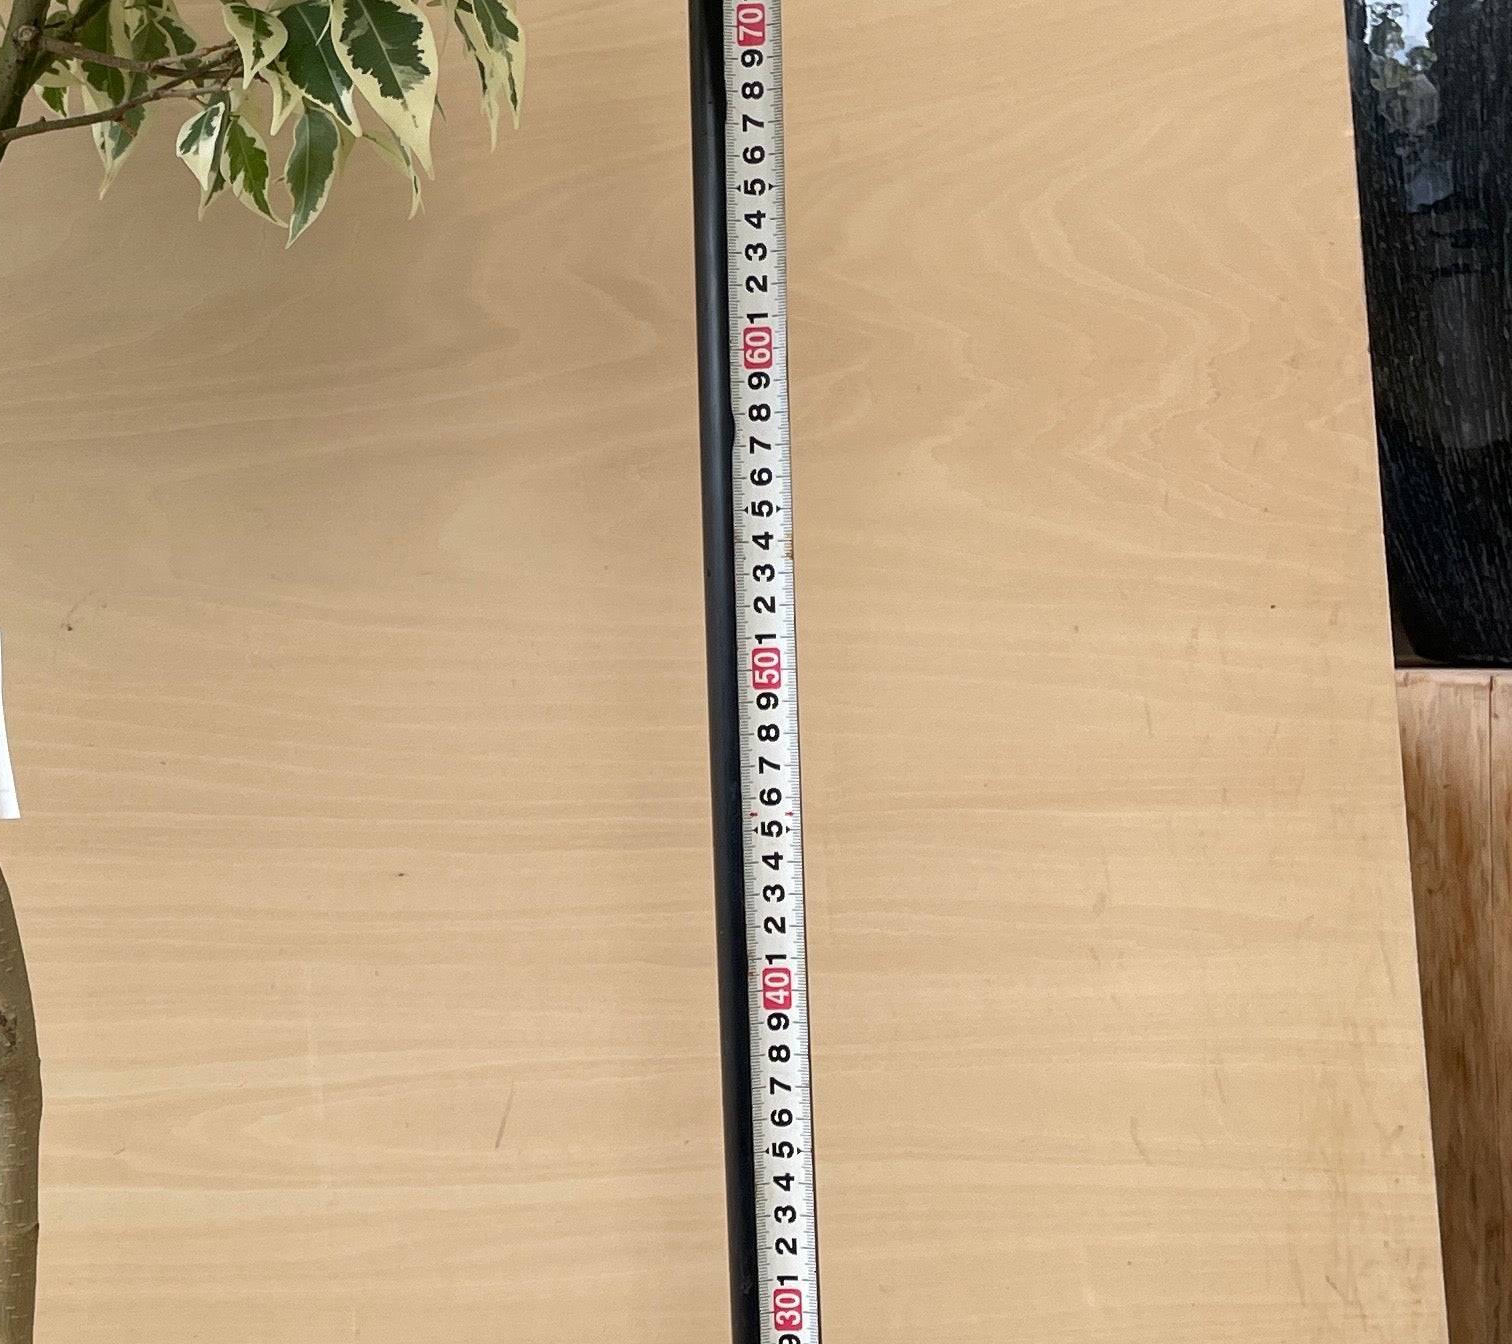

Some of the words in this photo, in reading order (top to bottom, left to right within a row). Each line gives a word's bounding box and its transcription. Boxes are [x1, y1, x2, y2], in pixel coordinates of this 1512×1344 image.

[739, 6, 763, 43] 70
[740, 48, 764, 68] 9
[741, 80, 764, 100] 8
[741, 113, 765, 133] 7
[742, 145, 766, 165] 6
[743, 178, 766, 196] 5
[744, 209, 766, 230] 4
[744, 242, 768, 262] 3
[745, 274, 768, 294] 2
[746, 312, 769, 324] 1
[746, 329, 770, 366] 60
[747, 371, 771, 391] 9
[748, 403, 771, 422] 8
[749, 436, 772, 455] 7
[749, 467, 773, 486] 6
[750, 500, 774, 518] 5
[751, 531, 774, 551] 4
[752, 563, 775, 583] 3
[753, 596, 776, 614] 2
[754, 633, 777, 645] 1
[754, 649, 779, 686] 50
[756, 691, 779, 711] 9
[757, 723, 780, 742] 8
[758, 756, 781, 775] 7
[759, 787, 782, 806] 6
[760, 820, 783, 838] 5
[761, 851, 784, 871] 4
[762, 884, 785, 903] 3
[763, 916, 786, 934] 2
[765, 954, 787, 965] 1
[765, 969, 790, 1007] 40
[766, 1012, 790, 1031] 9
[767, 1044, 791, 1063] 8
[769, 1076, 792, 1095] 7
[770, 1108, 793, 1127] 6
[771, 1141, 795, 1159] 5
[772, 1172, 795, 1192] 4
[773, 1205, 797, 1224] 3
[774, 1237, 798, 1255] 2
[776, 1275, 799, 1287] 1
[775, 1290, 800, 1328] 30
